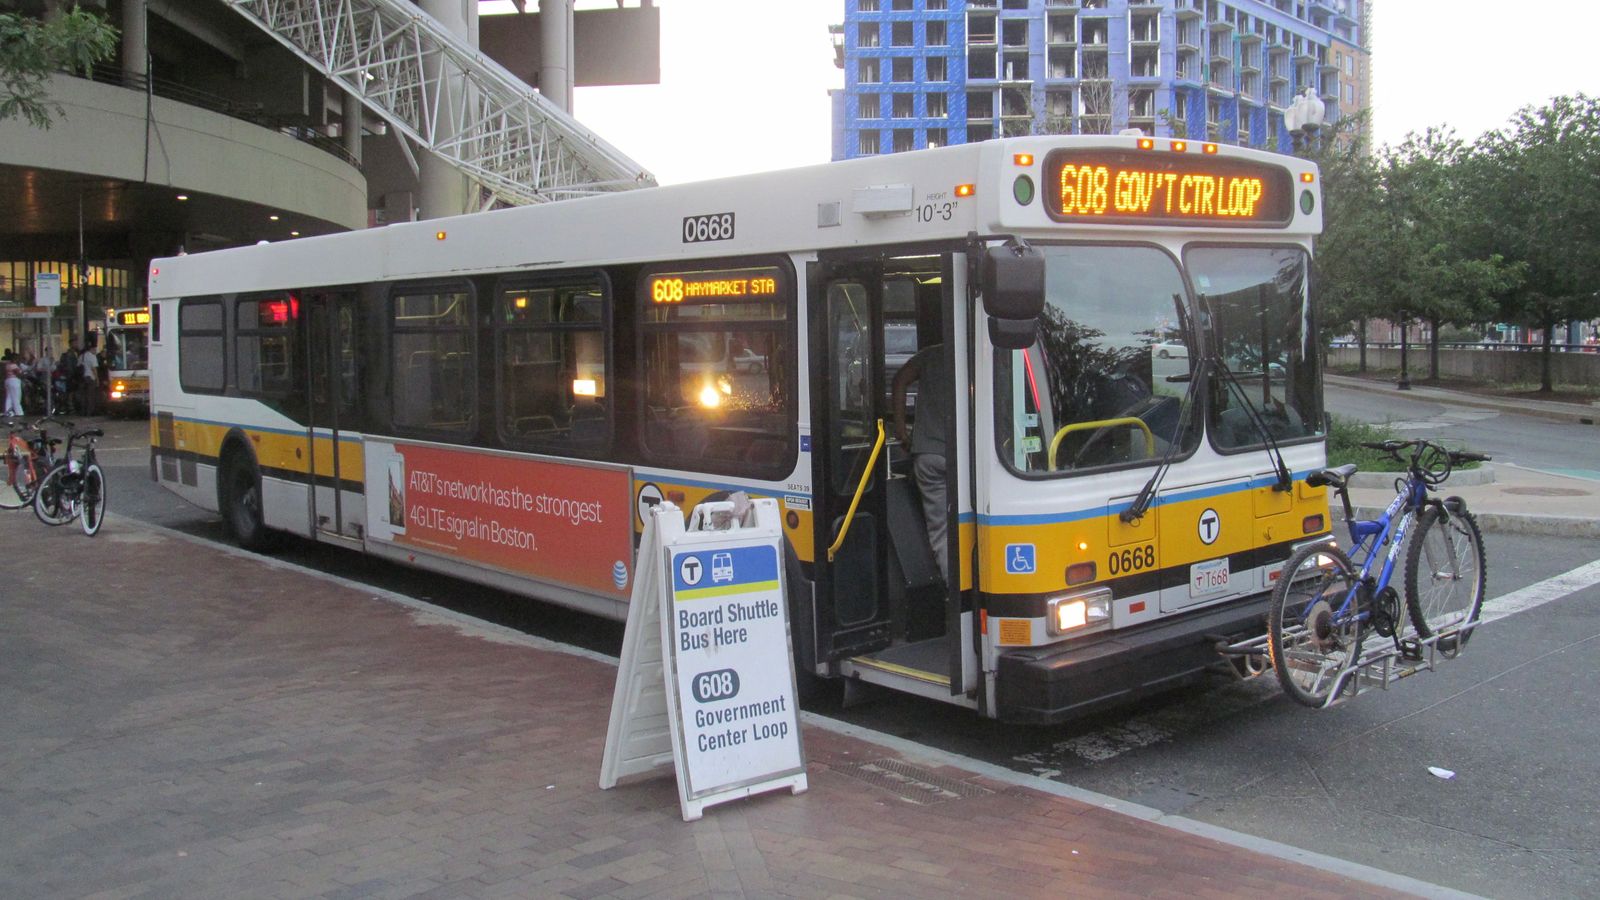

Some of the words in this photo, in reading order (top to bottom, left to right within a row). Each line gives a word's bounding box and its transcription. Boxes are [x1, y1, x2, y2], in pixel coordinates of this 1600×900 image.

[926, 192, 948, 201] HEIGHT
[1060, 164, 1109, 214] 608
[1113, 169, 1177, 213] GOV'T
[1178, 174, 1213, 214] CTR
[1216, 177, 1262, 216] LOOP
[685, 214, 733, 241] 0668
[653, 279, 684, 302] 608
[685, 280, 748, 296] HAYMARKET
[751, 279, 775, 294] STA
[443, 480, 488, 504] network
[488, 481, 511, 508] has
[511, 486, 533, 511] the
[535, 493, 603, 526] strongest
[446, 515, 479, 540] signal
[479, 517, 490, 540] in
[490, 520, 539, 551] Boston.
[1202, 517, 1216, 540] T
[684, 562, 700, 581] T
[1109, 545, 1155, 575] 0668
[1206, 568, 1228, 588] T668
[679, 605, 723, 629] Board
[727, 599, 779, 623] Shuttle
[680, 631, 709, 652] Bus
[713, 627, 748, 647] Here
[699, 671, 733, 699] 608
[695, 694, 786, 729] Government
[697, 728, 748, 753] Center
[752, 721, 789, 741] Loop
